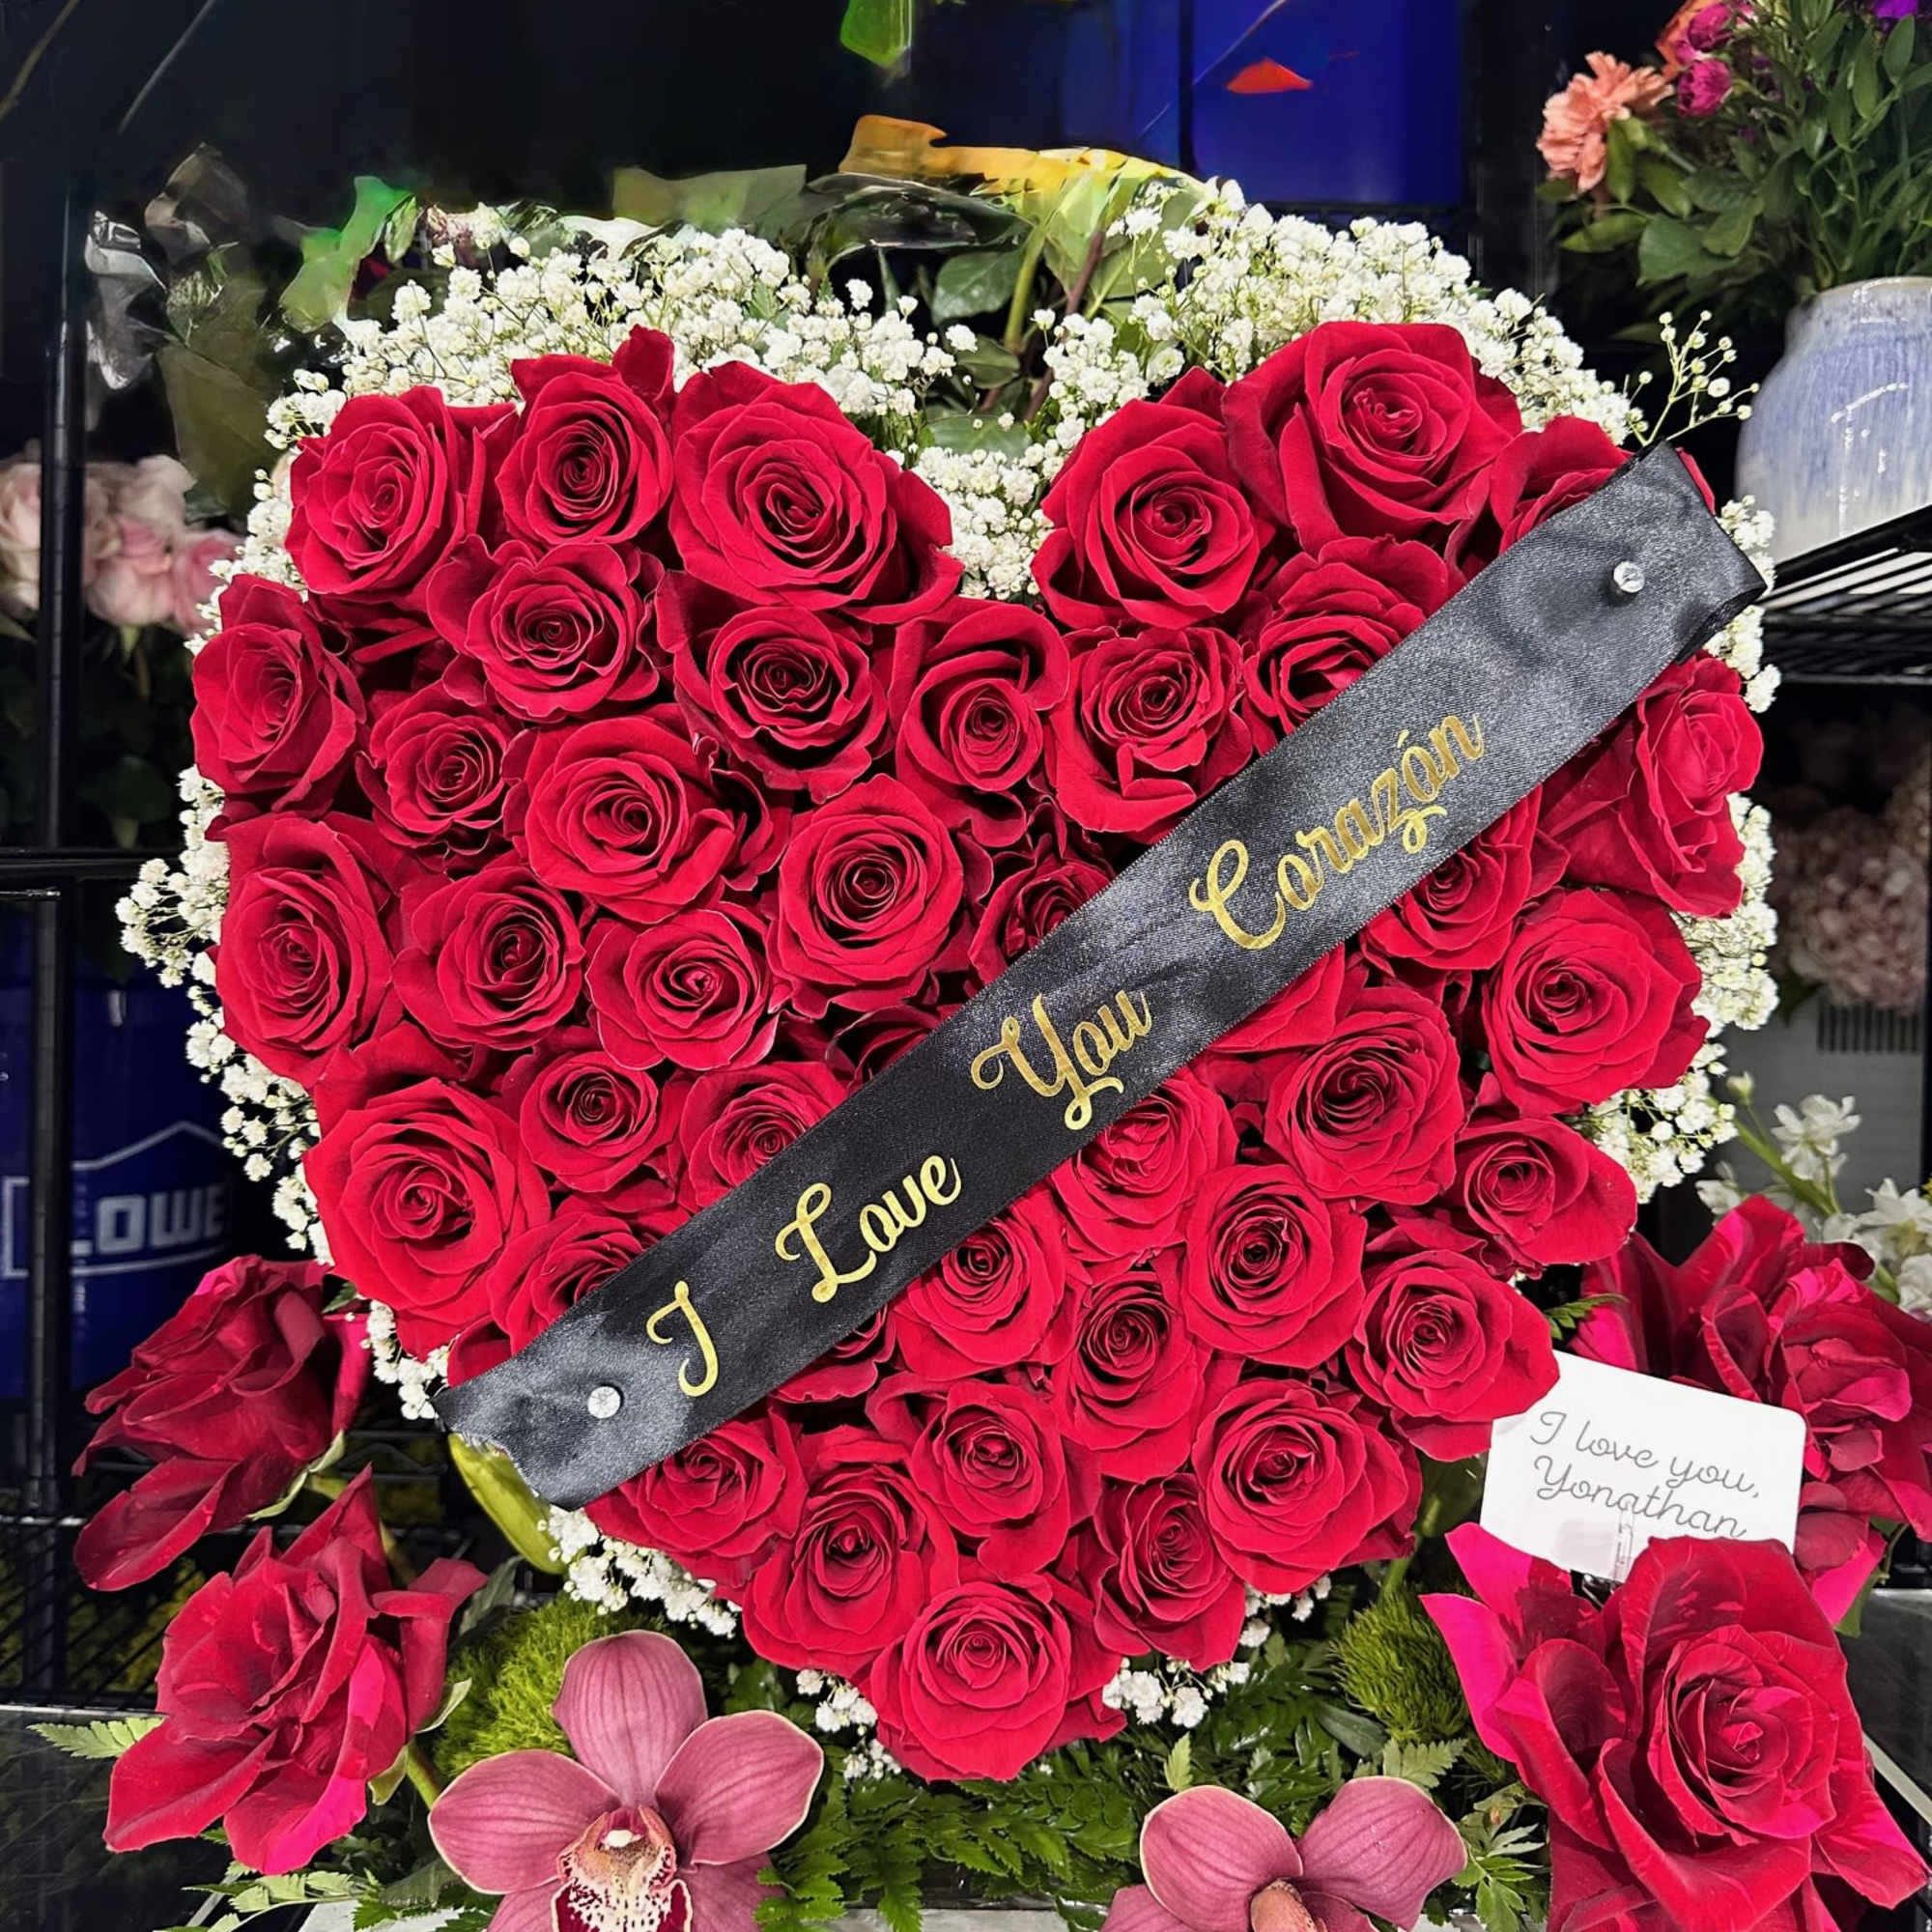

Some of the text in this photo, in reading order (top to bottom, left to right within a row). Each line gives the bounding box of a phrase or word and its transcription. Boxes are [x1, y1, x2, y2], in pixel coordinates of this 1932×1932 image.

[645, 712, 1484, 1398] I Love You Corazón
[1529, 1410, 1760, 1499] I love you,
[1533, 1455, 1747, 1539] Yonathan
